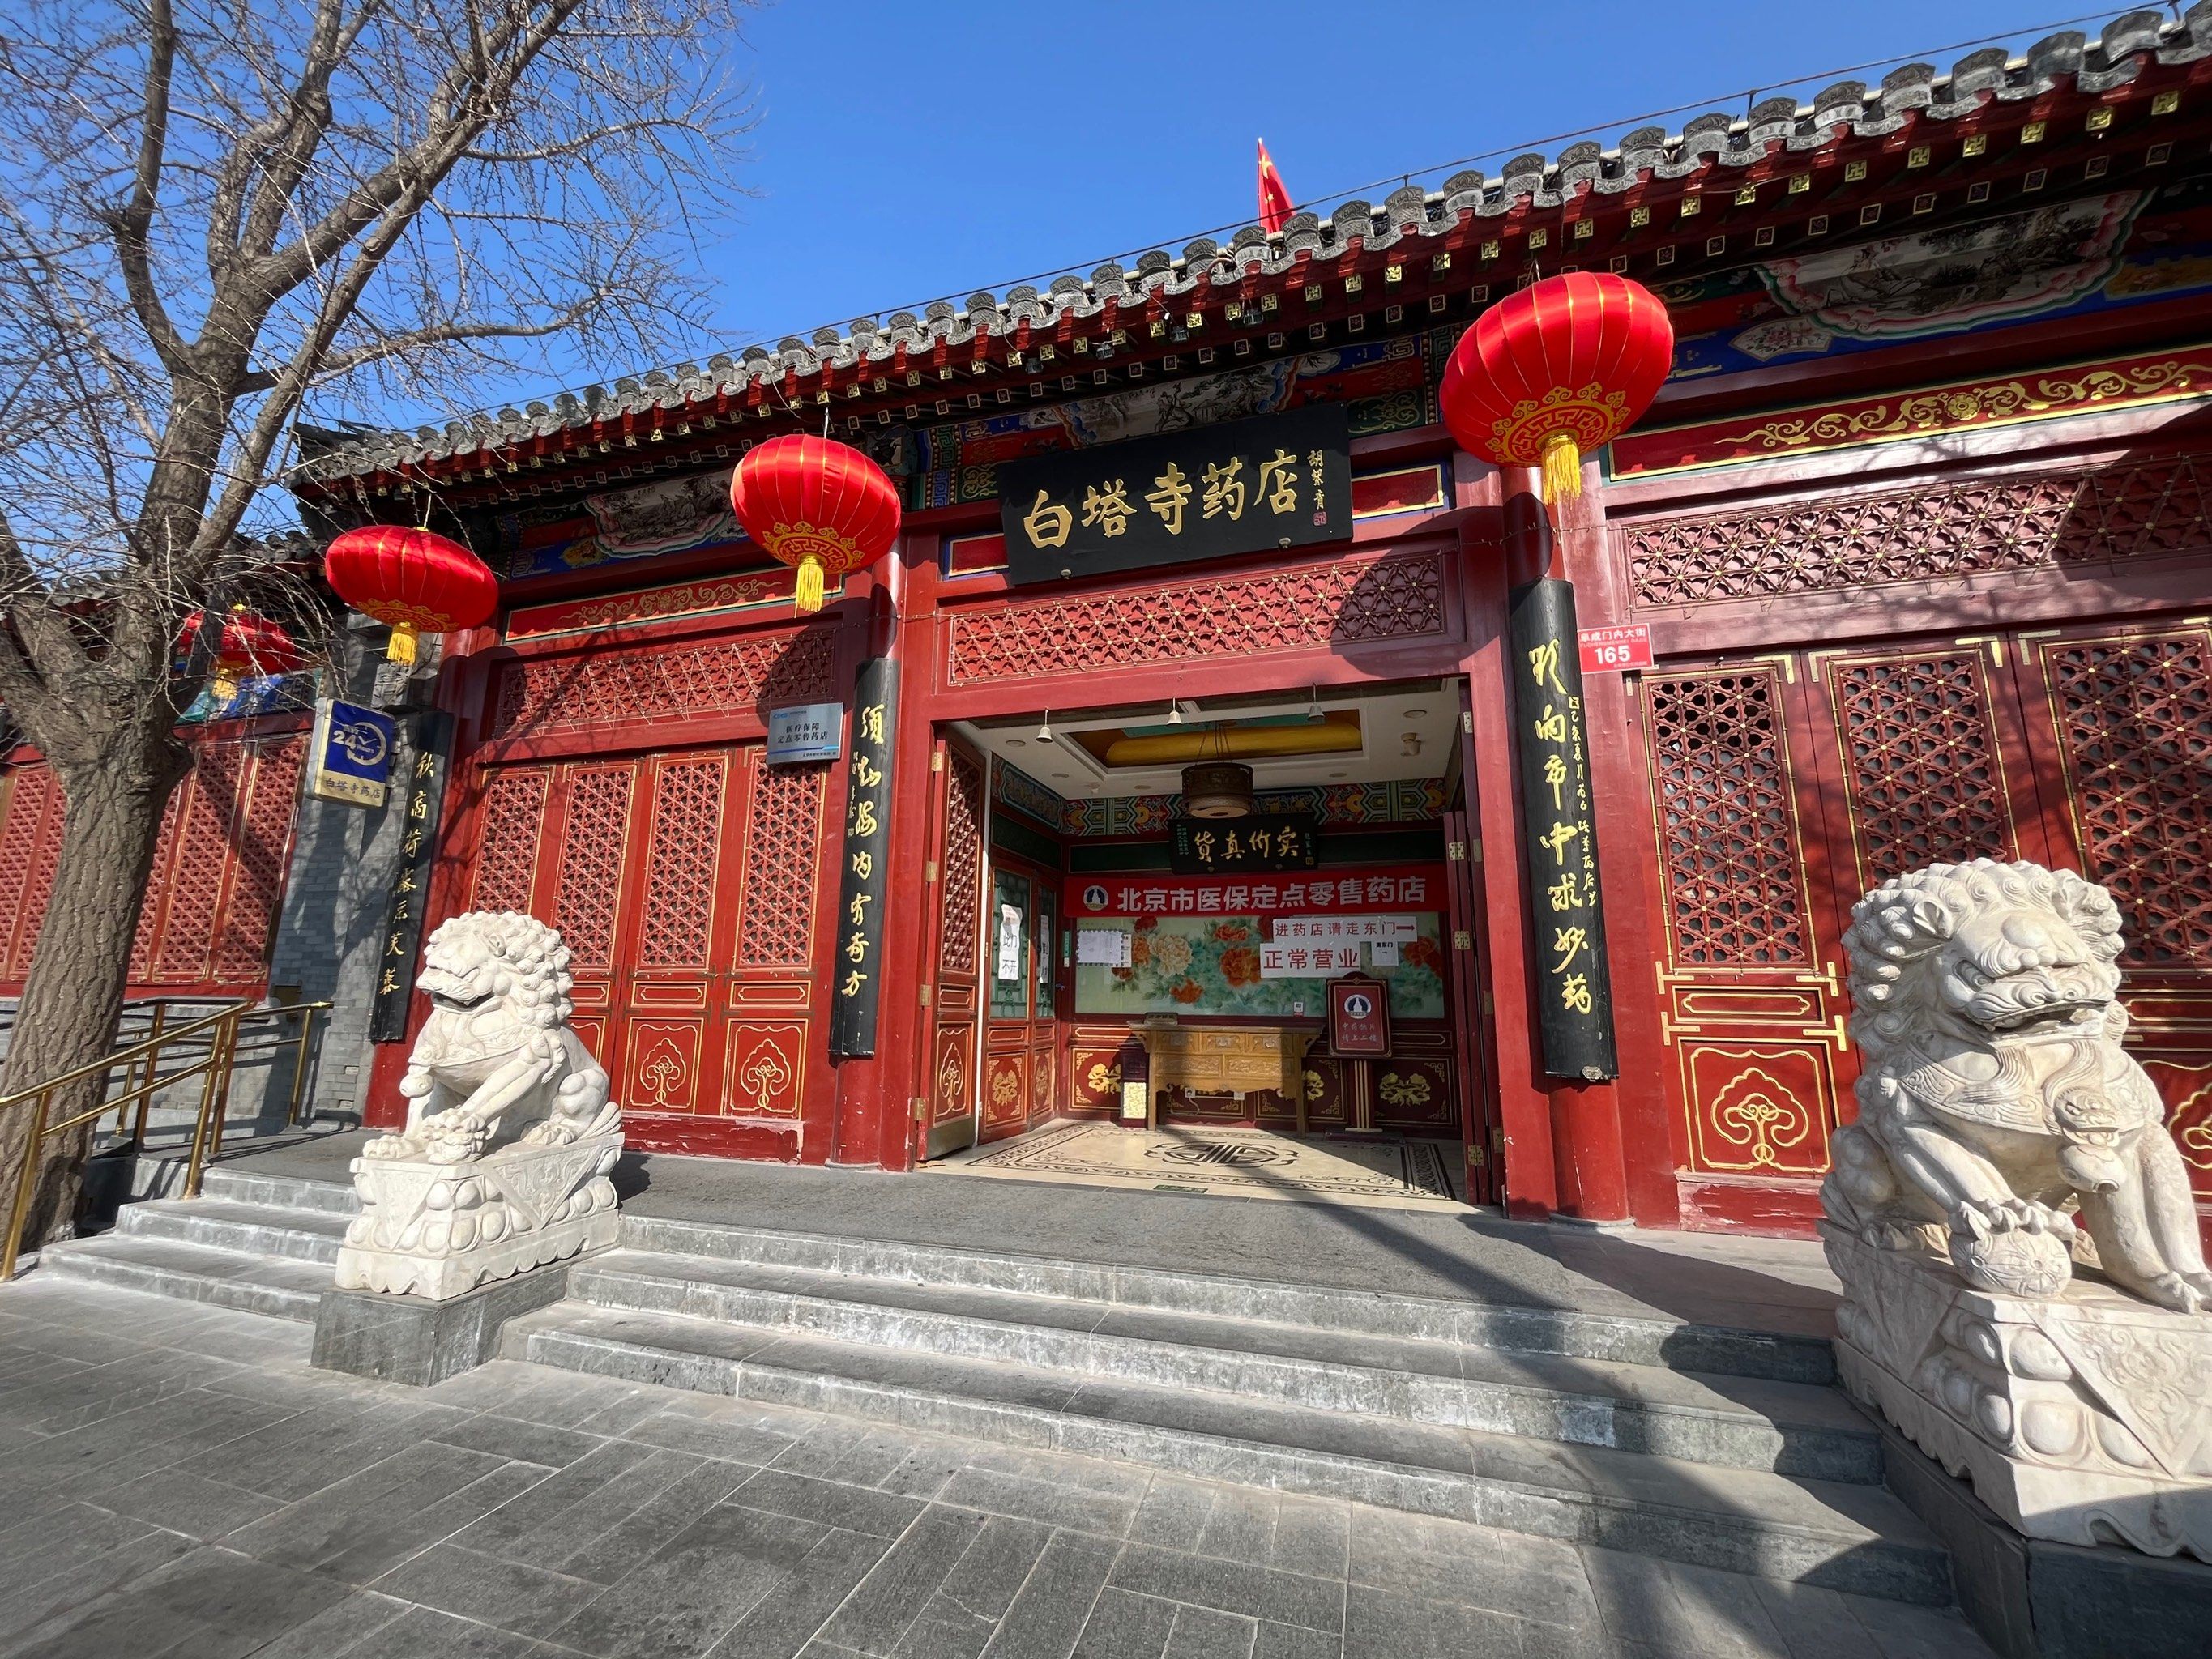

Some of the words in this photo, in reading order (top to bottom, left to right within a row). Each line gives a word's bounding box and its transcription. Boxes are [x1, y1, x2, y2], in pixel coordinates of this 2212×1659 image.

[1023, 449, 1298, 548] 白塔寺药店
[1580, 628, 1646, 642] 阜成门内大街
[1594, 645, 1631, 664] 165
[777, 731, 828, 744] 定点零售药店
[786, 723, 819, 734] 医疗保障
[332, 730, 357, 750] 24
[326, 778, 381, 799] 白塔寺药店
[1117, 876, 1426, 912] 北京市医保定点零售药店
[1275, 921, 1396, 936] 进药店请走东门
[1002, 959, 1018, 975] 不开
[1263, 948, 1360, 970] 正常营业
